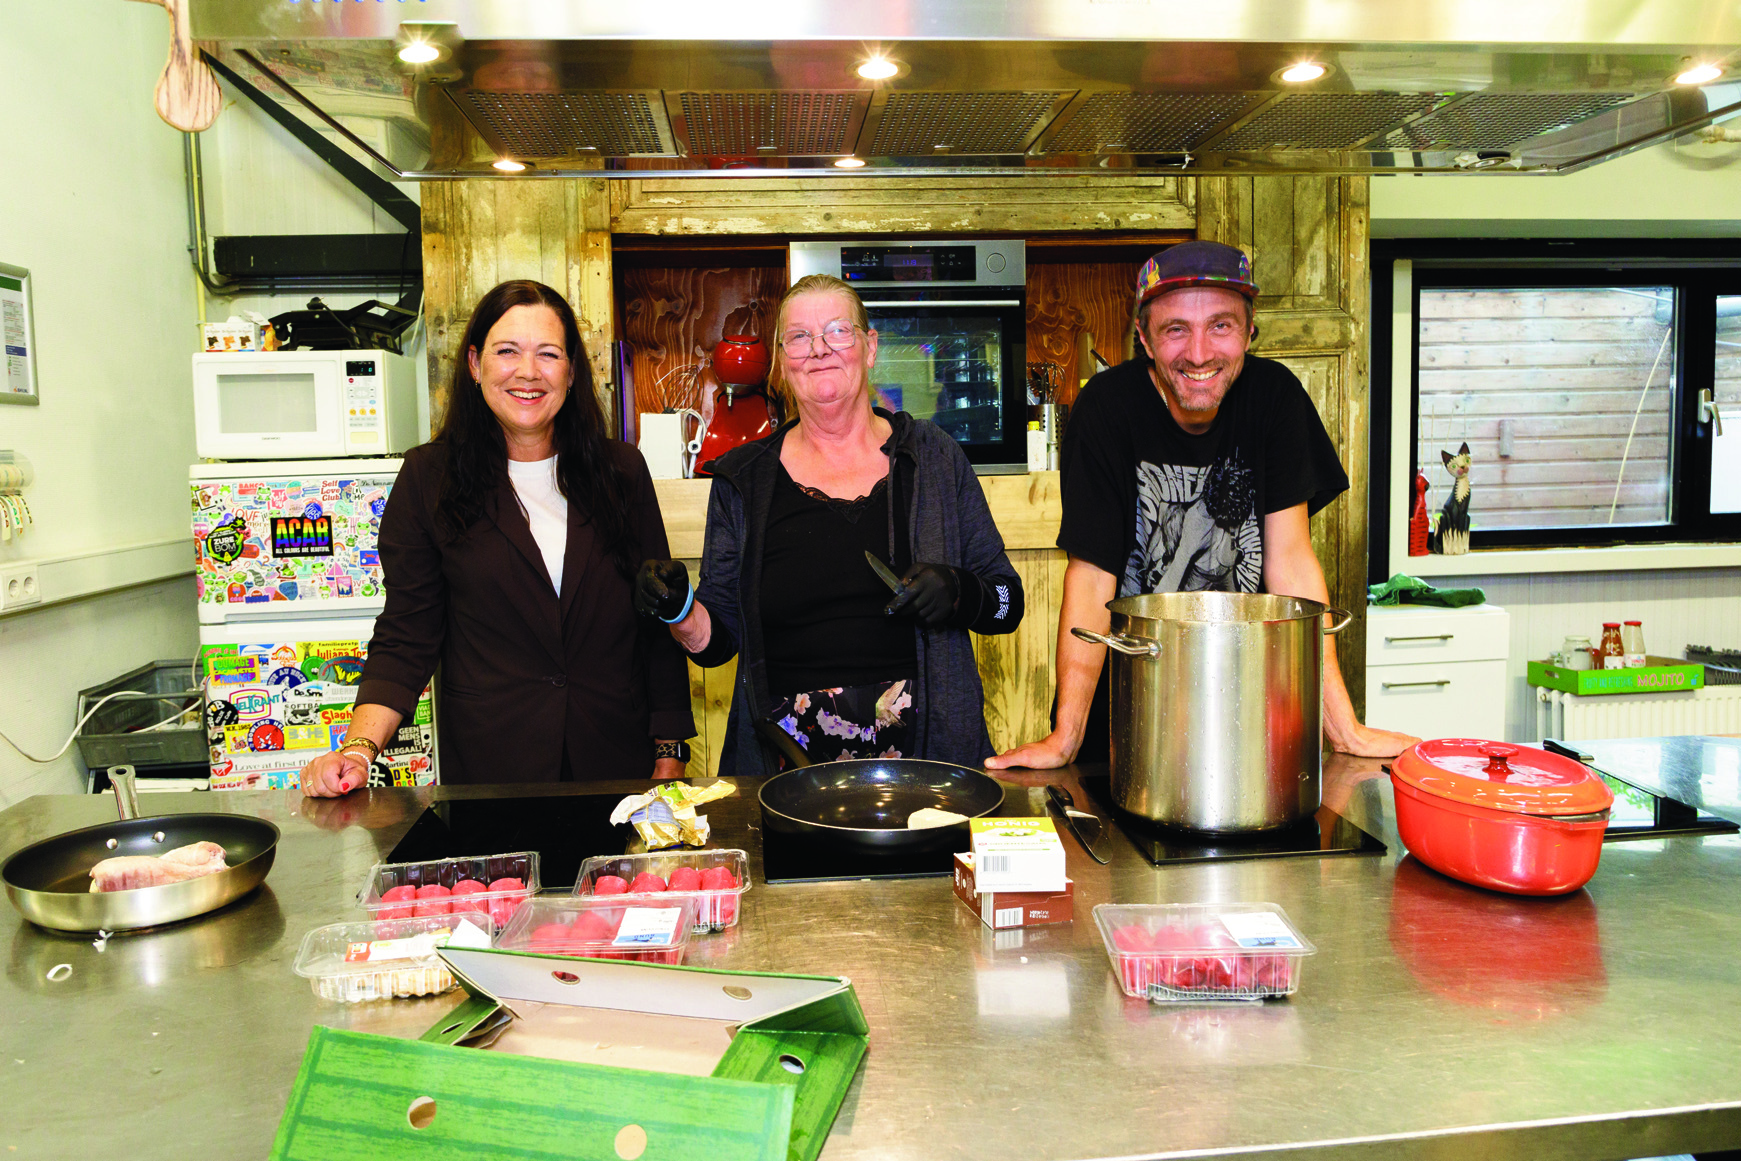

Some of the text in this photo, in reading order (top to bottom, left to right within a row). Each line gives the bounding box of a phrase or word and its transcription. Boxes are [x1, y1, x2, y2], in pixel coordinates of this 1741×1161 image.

[321, 480, 338, 488] Self
[320, 487, 341, 495] Love
[275, 517, 330, 549] ACAB
[213, 536, 235, 545] ZURE
[214, 542, 237, 553] BOM
[1637, 672, 1685, 687] MOJITO
[399, 727, 419, 735] GEEN
[398, 733, 420, 742] MENS
